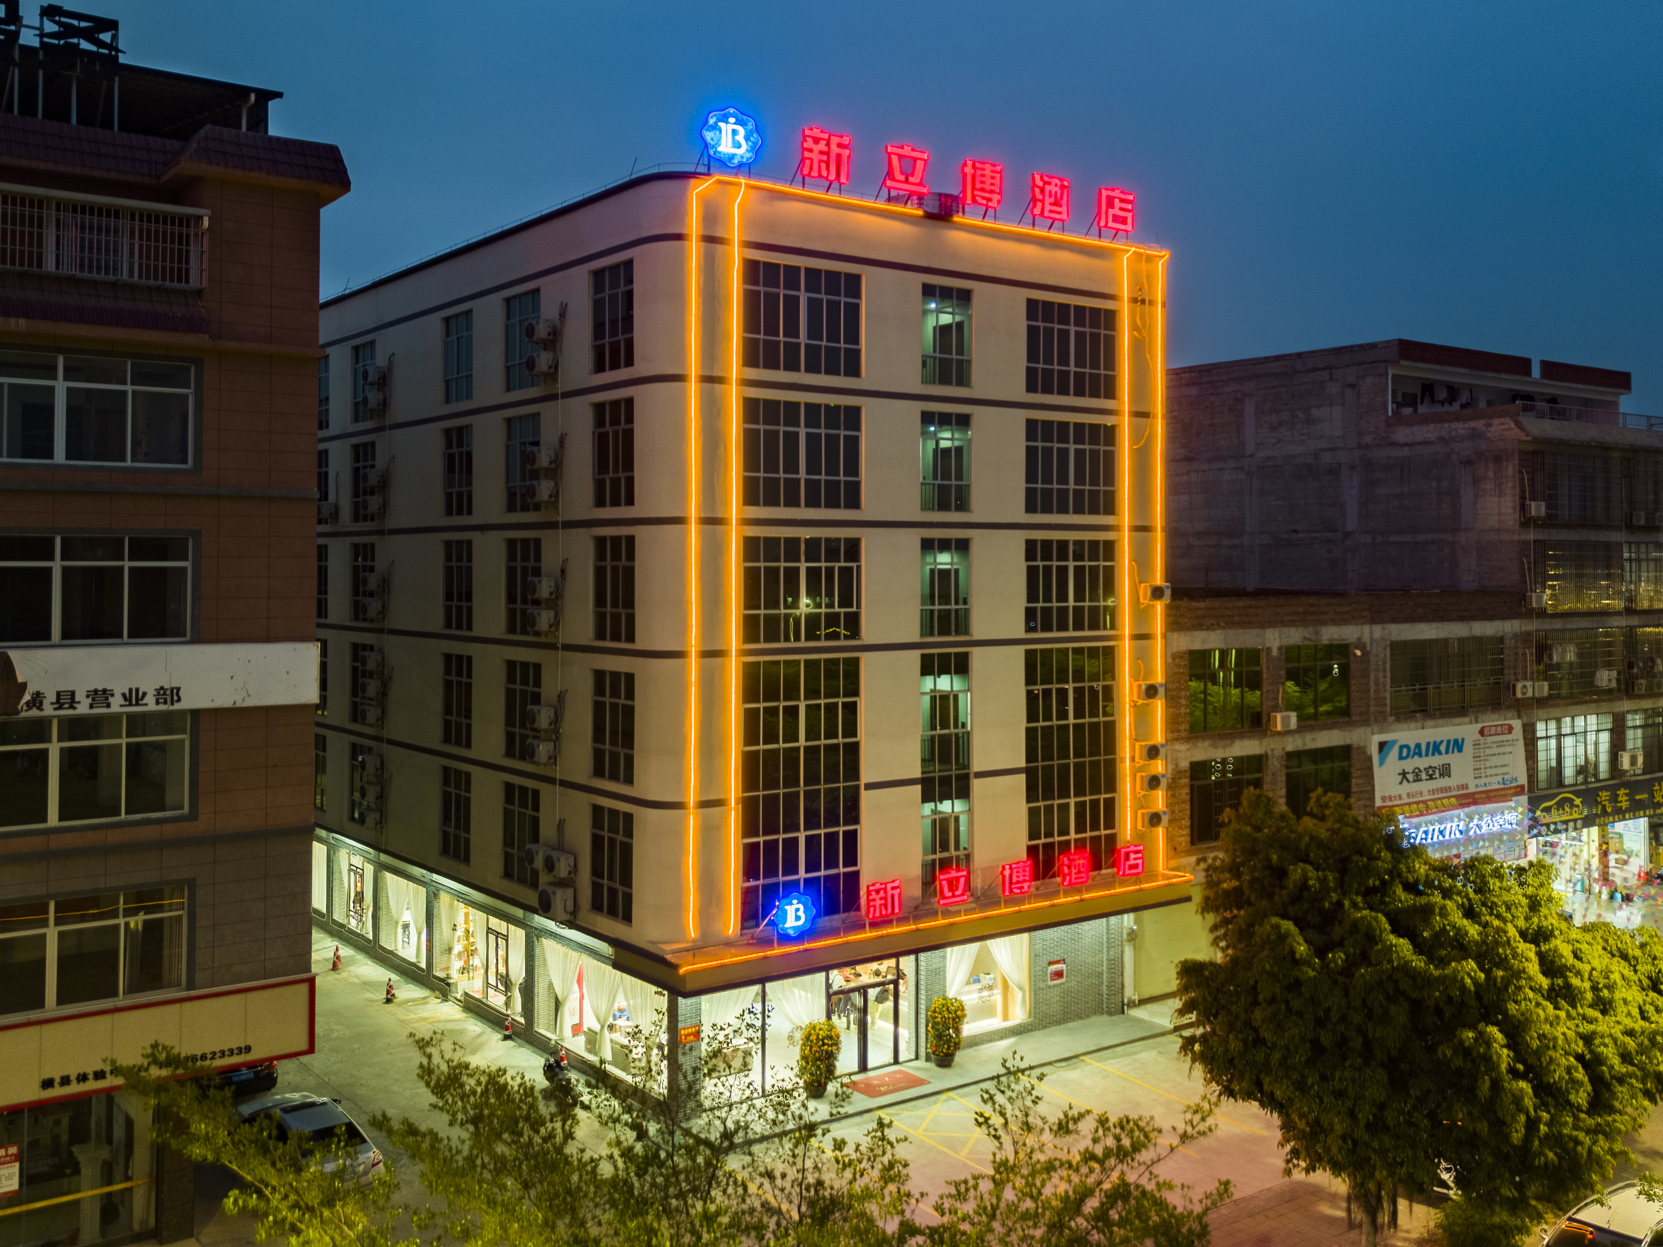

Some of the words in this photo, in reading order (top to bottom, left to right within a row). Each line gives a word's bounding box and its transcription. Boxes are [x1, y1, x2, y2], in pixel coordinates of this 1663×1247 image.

[801, 126, 1136, 233] 新立博酒店
[1398, 737, 1465, 761] DAIKIN
[1397, 763, 1451, 785] 大金空调
[1468, 812, 1518, 836] 大金空调
[866, 844, 1146, 921] 新立博酒店
